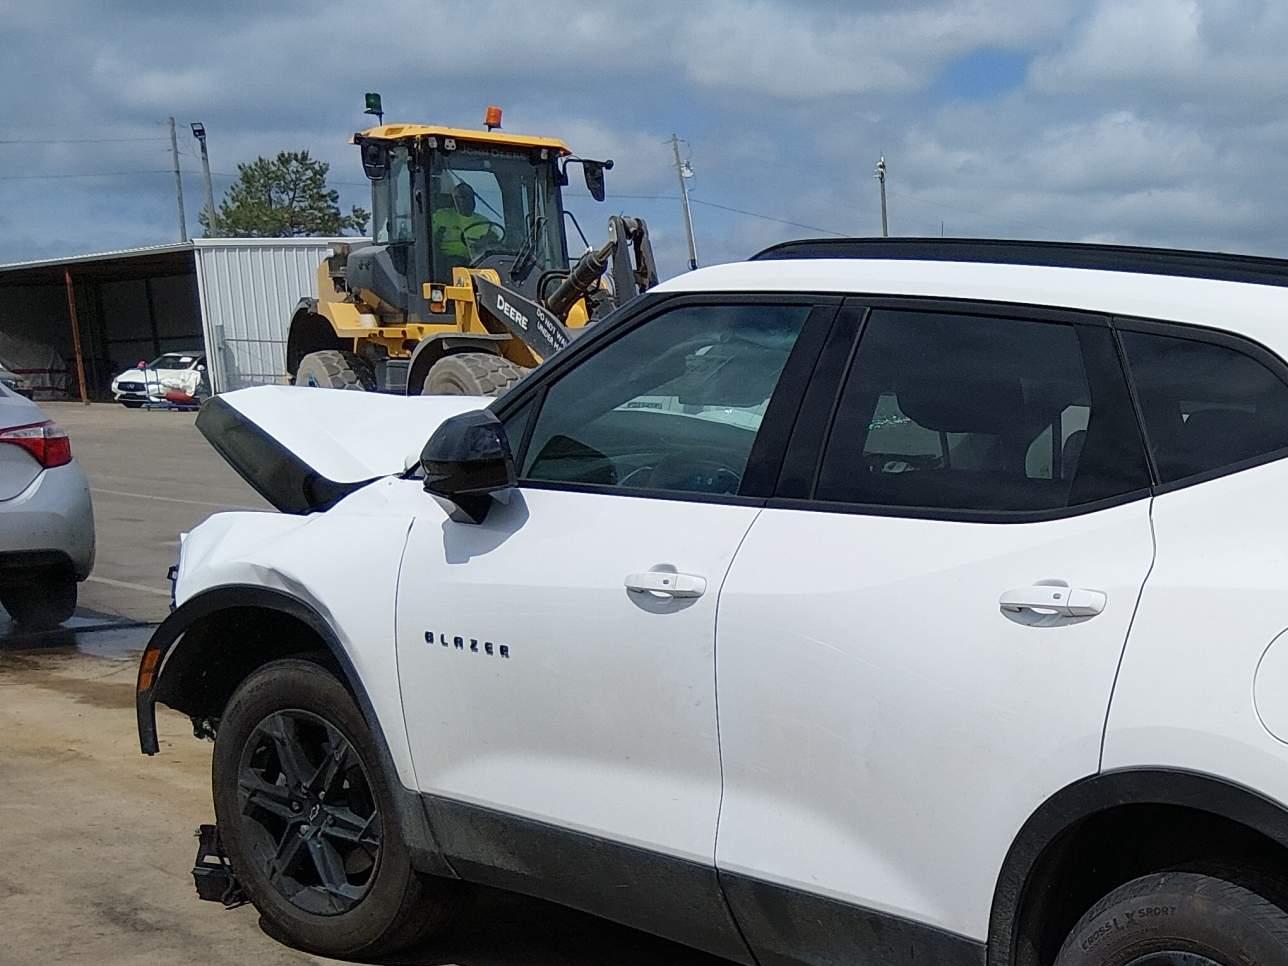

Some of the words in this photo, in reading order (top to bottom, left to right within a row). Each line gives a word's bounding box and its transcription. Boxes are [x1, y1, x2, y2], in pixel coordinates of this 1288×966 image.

[496, 294, 529, 330] DEERE
[536, 308, 545, 321] DO
[544, 317, 556, 334] NOT
[537, 321, 554, 346] UNDER
[424, 631, 510, 659] BLAZER
[1138, 906, 1177, 918] SPORT
